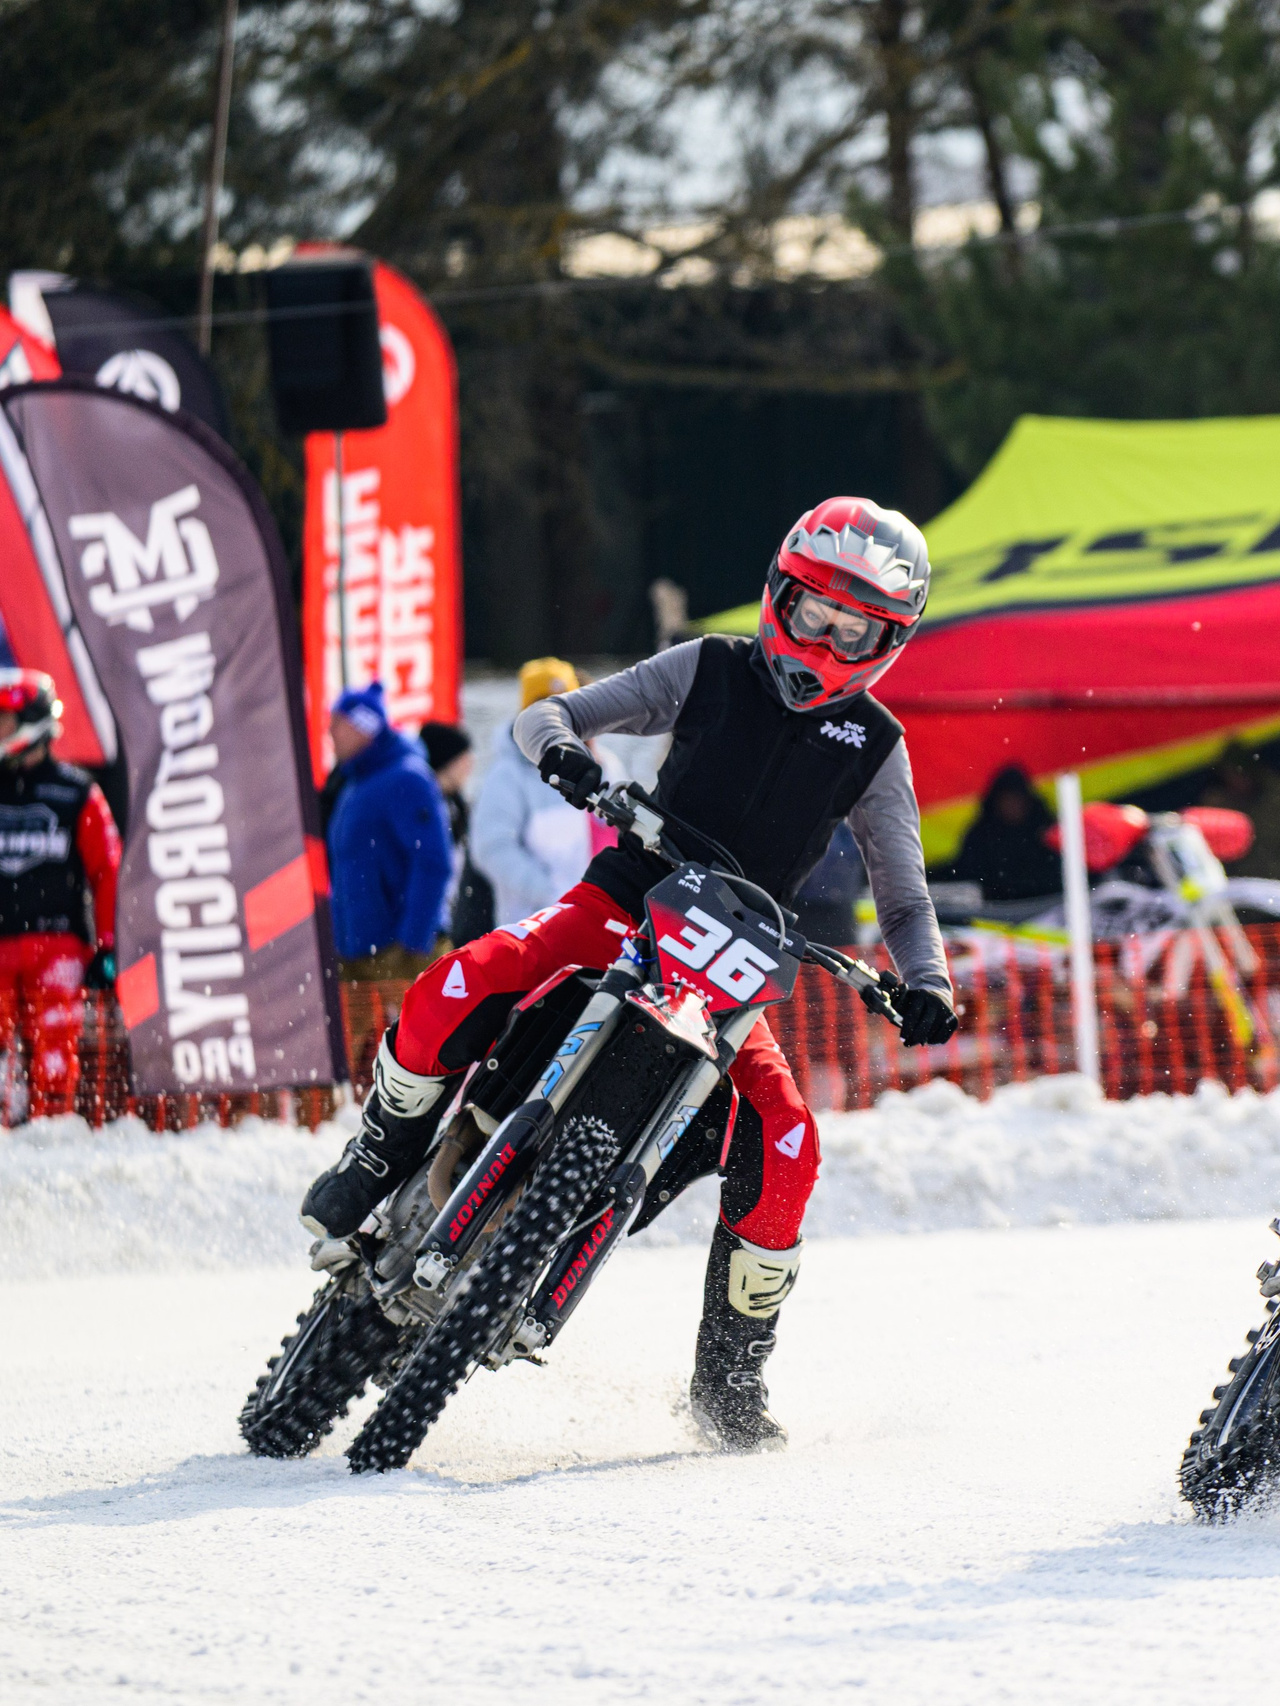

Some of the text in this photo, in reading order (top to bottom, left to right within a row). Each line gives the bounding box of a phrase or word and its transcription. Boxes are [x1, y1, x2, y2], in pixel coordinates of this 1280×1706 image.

[657, 905, 780, 1003] 36
[758, 921, 794, 947] BABEKO
[449, 1142, 517, 1242] DUNLOP
[551, 1207, 616, 1310] DUNLOP
